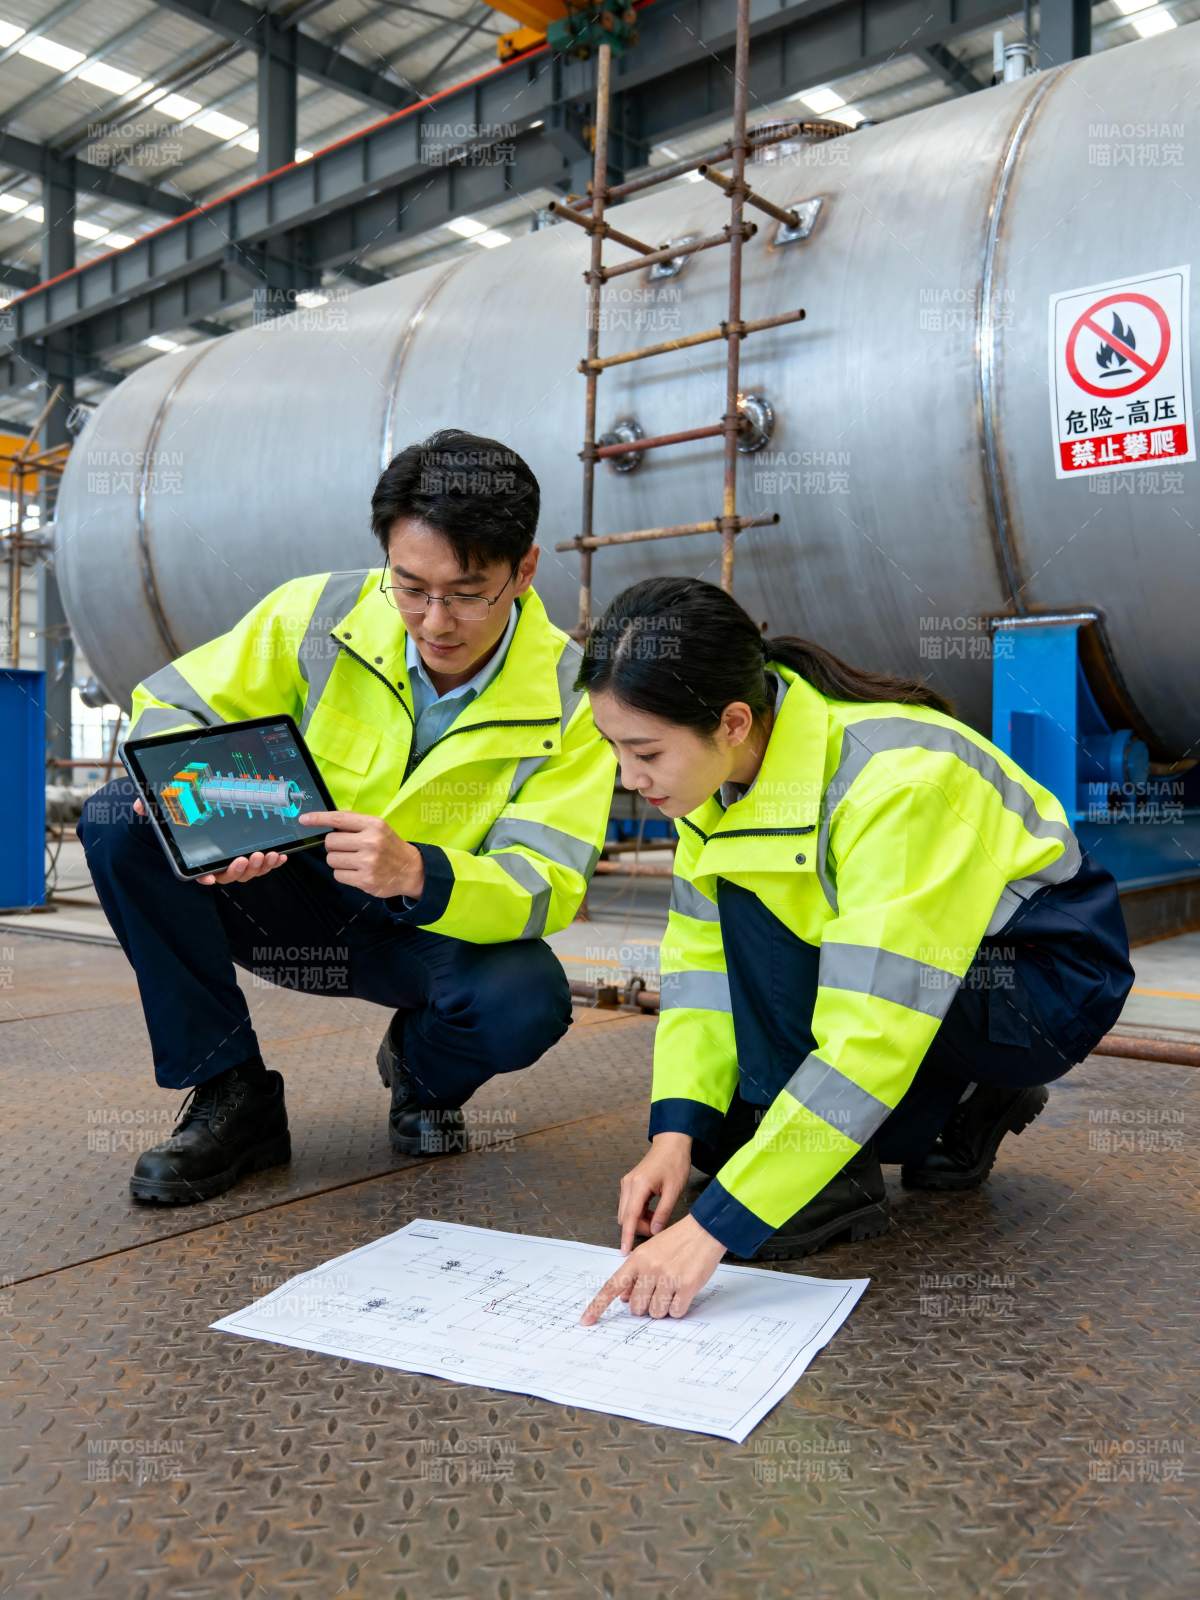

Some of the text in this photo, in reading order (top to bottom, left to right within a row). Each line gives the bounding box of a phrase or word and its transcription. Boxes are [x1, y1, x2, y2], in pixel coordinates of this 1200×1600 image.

[1065, 396, 1178, 435] 危险-高压
[1071, 429, 1176, 467] 禁止攀爬
